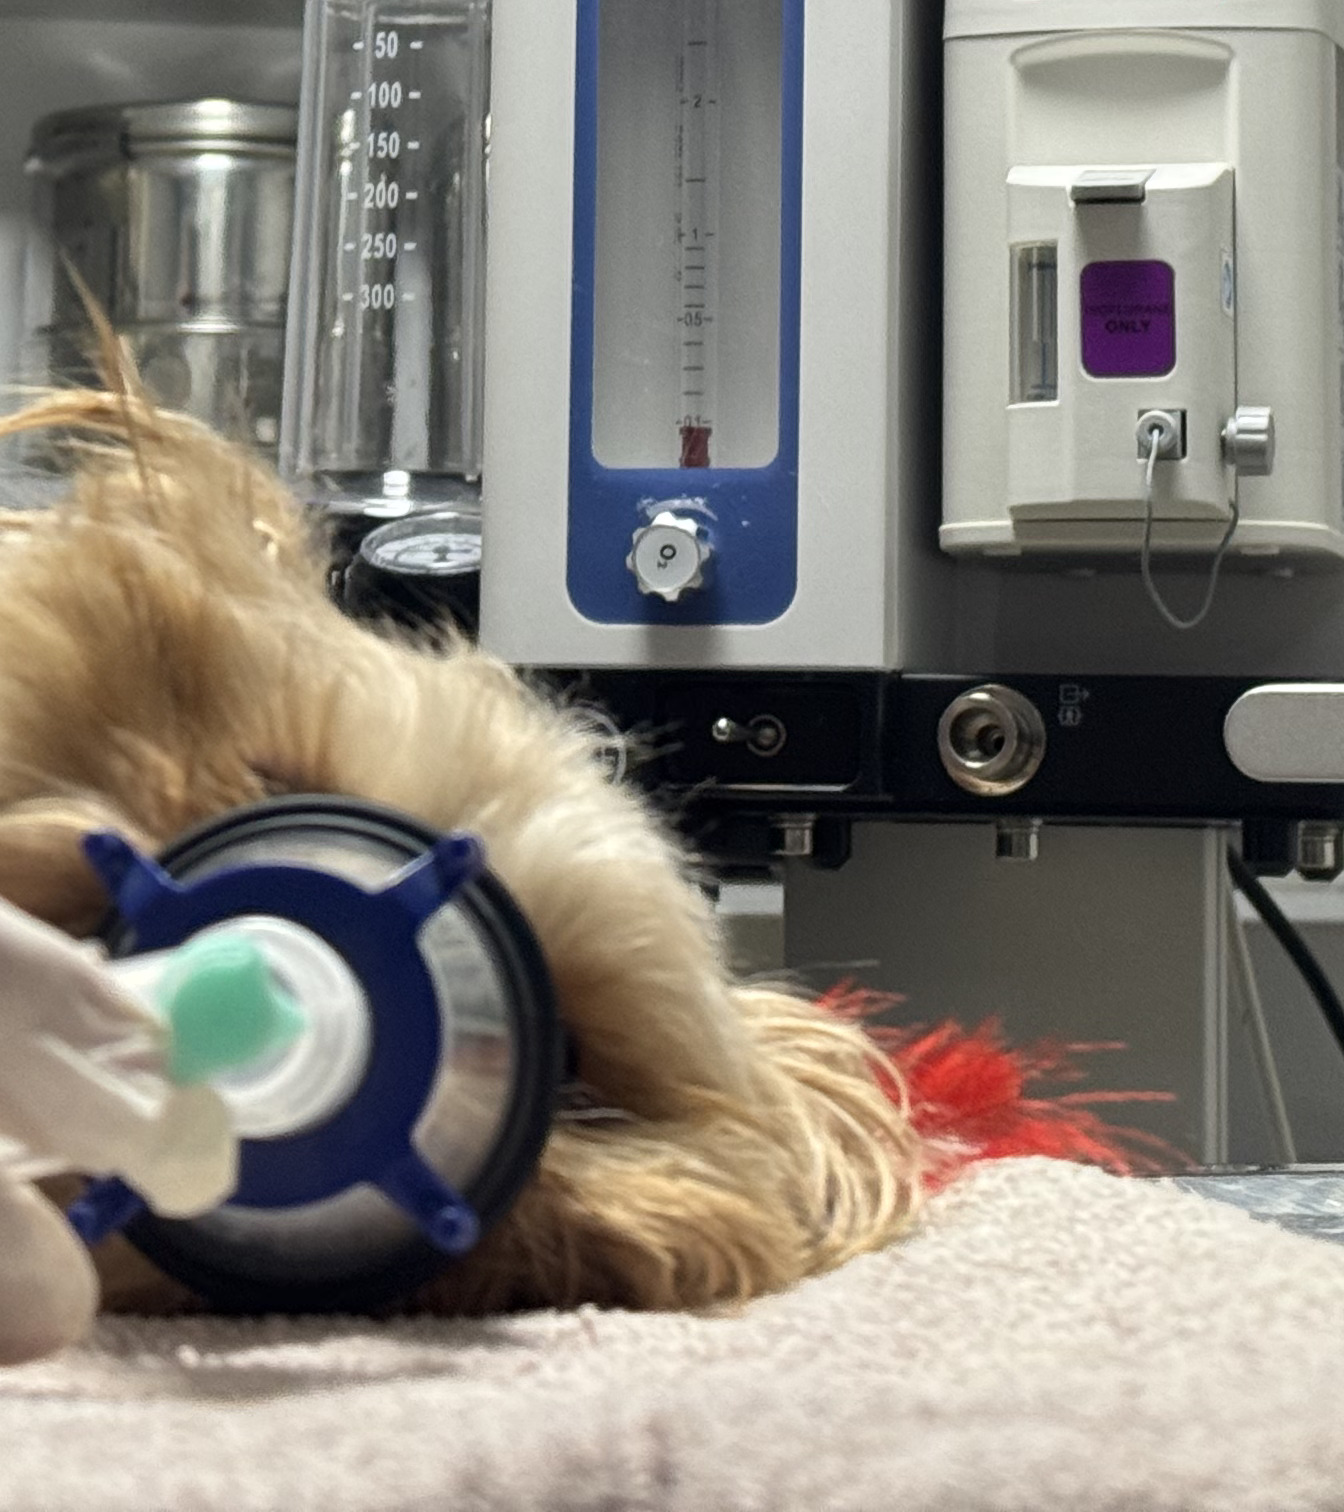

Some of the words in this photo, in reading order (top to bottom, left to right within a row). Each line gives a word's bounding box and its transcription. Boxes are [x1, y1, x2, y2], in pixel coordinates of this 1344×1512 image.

[375, 32, 399, 58] 50
[368, 82, 402, 108] 100
[693, 93, 702, 109] 2
[366, 132, 401, 158] 150
[363, 183, 399, 209] 200
[361, 233, 398, 259] 250
[359, 284, 395, 310] 300
[1105, 320, 1152, 335] ONLY
